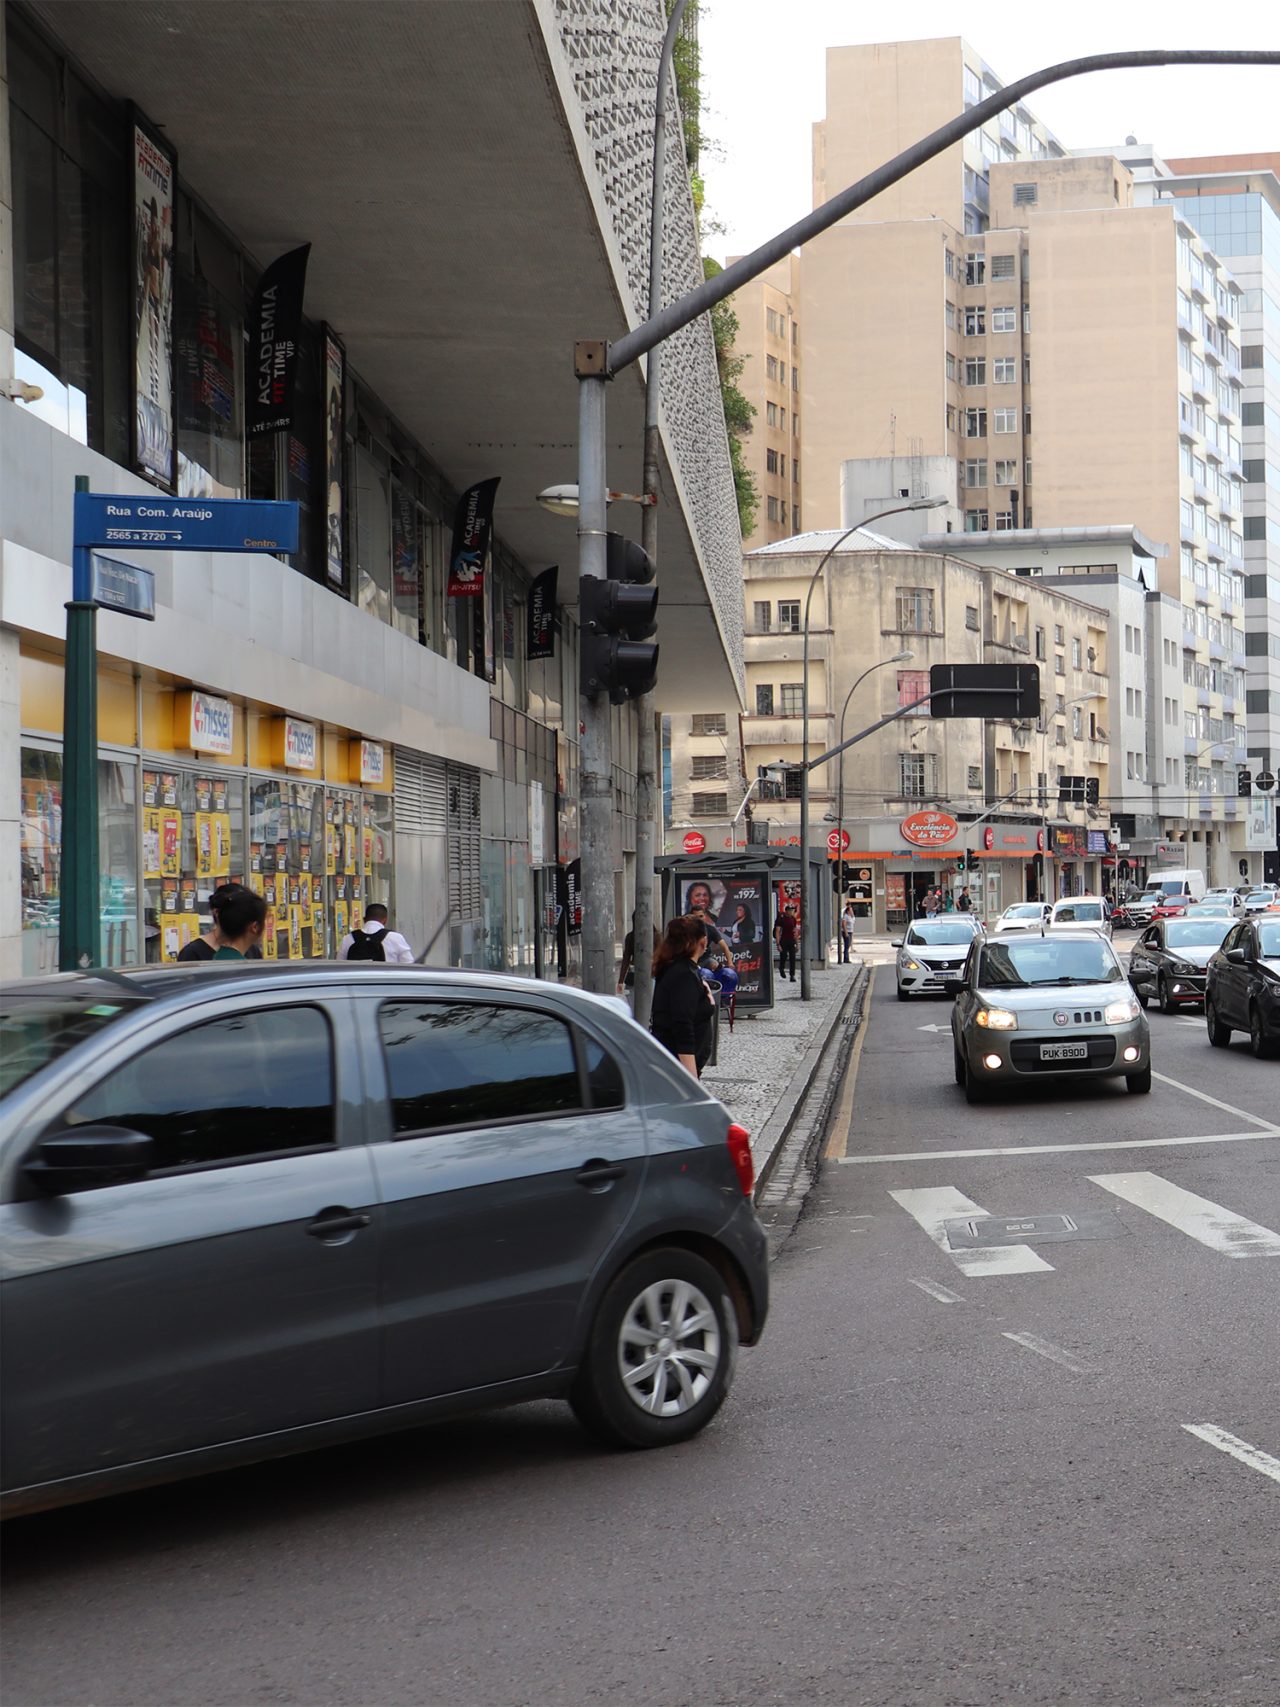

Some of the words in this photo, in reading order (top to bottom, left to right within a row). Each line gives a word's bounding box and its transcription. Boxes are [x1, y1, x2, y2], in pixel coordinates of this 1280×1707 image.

[258, 284, 279, 405] ACADEMIA
[286, 340, 295, 358] VIP
[274, 341, 287, 378] TIME
[107, 506, 131, 516] Rua
[137, 507, 169, 517] Com.
[172, 508, 212, 521] Araújo
[464, 490, 480, 546] ACADEMIA
[106, 531, 131, 540] 2565
[142, 532, 166, 541] 2720
[244, 538, 277, 547] Centro
[532, 586, 543, 644] ACADEMIA
